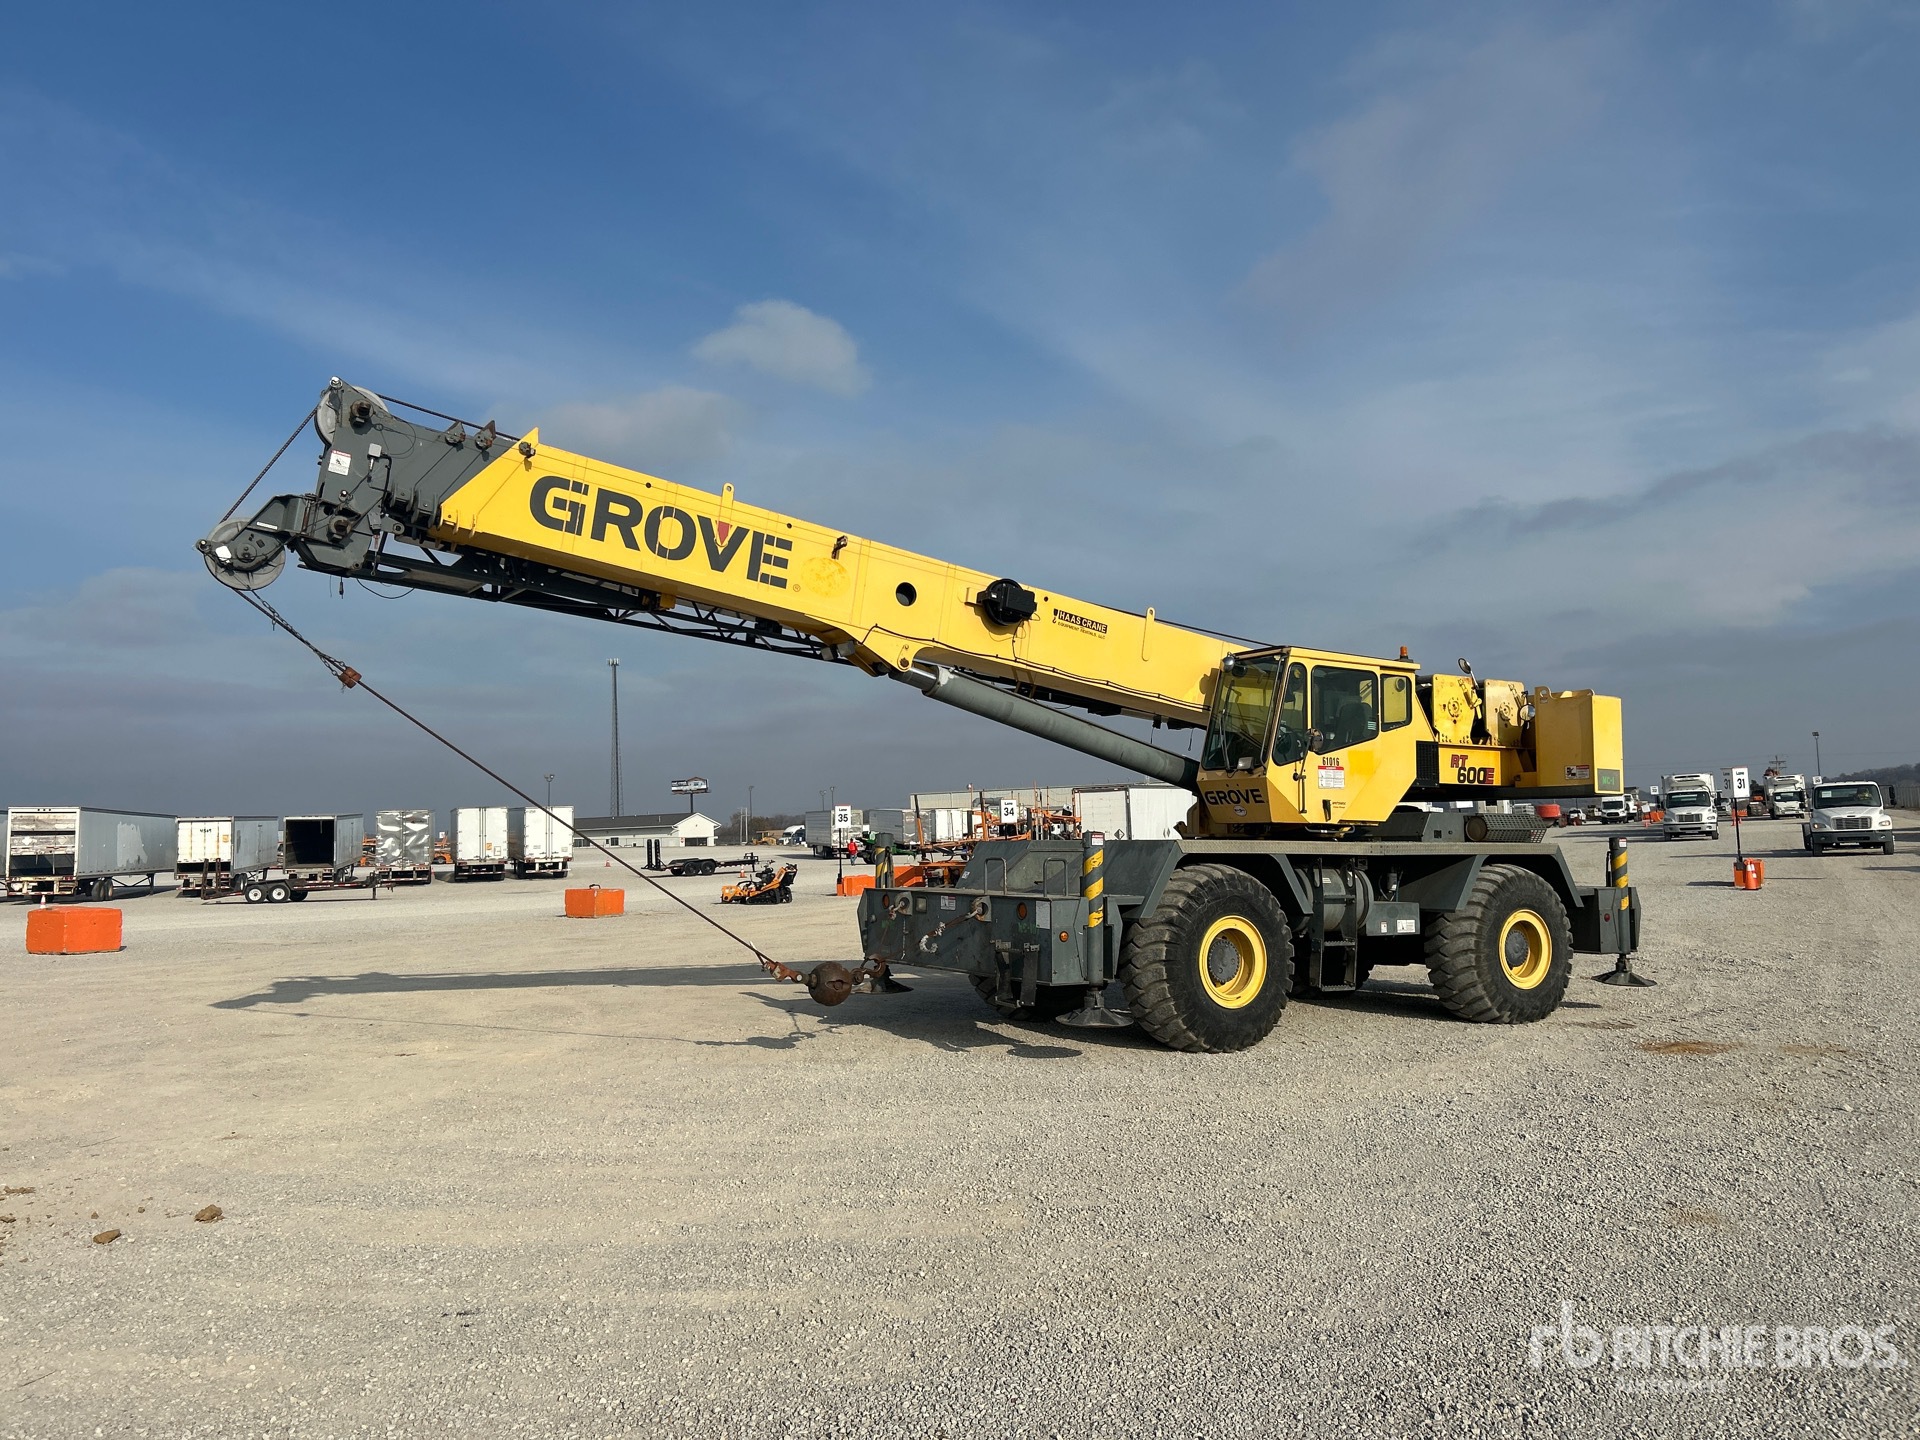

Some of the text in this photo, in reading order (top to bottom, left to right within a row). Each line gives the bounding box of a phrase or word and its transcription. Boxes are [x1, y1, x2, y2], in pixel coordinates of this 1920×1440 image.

[529, 475, 793, 589] GROVE
[1059, 611, 1107, 633] HAAS CRANE
[1322, 756, 1339, 766] 61016
[1450, 754, 1468, 768] RT
[1457, 767, 1495, 784] 600E
[1724, 778, 1731, 789] 31
[1737, 777, 1745, 789] 31
[1204, 788, 1266, 805] GROVE
[837, 813, 848, 822] 35
[1003, 807, 1014, 816] 34
